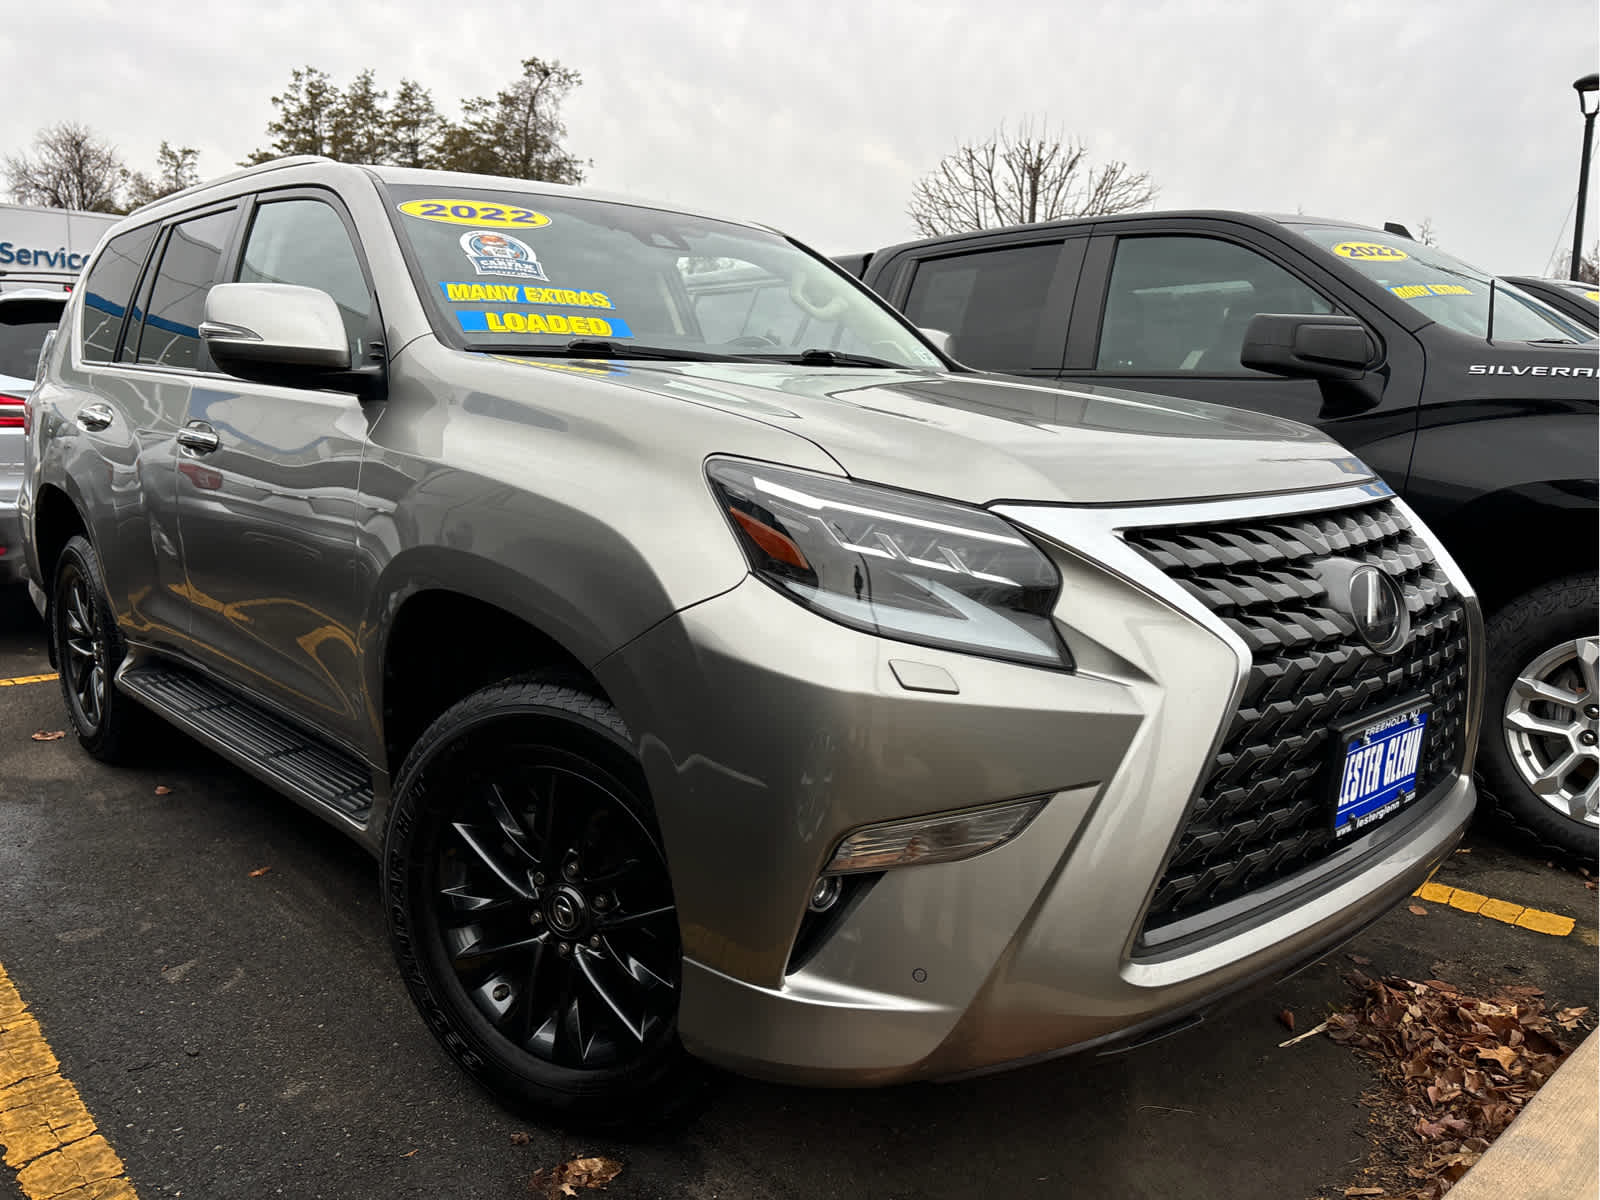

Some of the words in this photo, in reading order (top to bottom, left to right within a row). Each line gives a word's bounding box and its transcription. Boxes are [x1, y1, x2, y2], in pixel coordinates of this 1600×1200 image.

[421, 203, 537, 224] 2022
[1342, 246, 1404, 257] 2022
[446, 283, 520, 302] MANY
[524, 285, 612, 309] EXTRAS
[485, 311, 613, 337] LOADED
[1468, 364, 1599, 378] SILVERA
[1409, 708, 1421, 720] NJ
[1338, 742, 1385, 807] LESTER
[1383, 727, 1424, 787] GLENN
